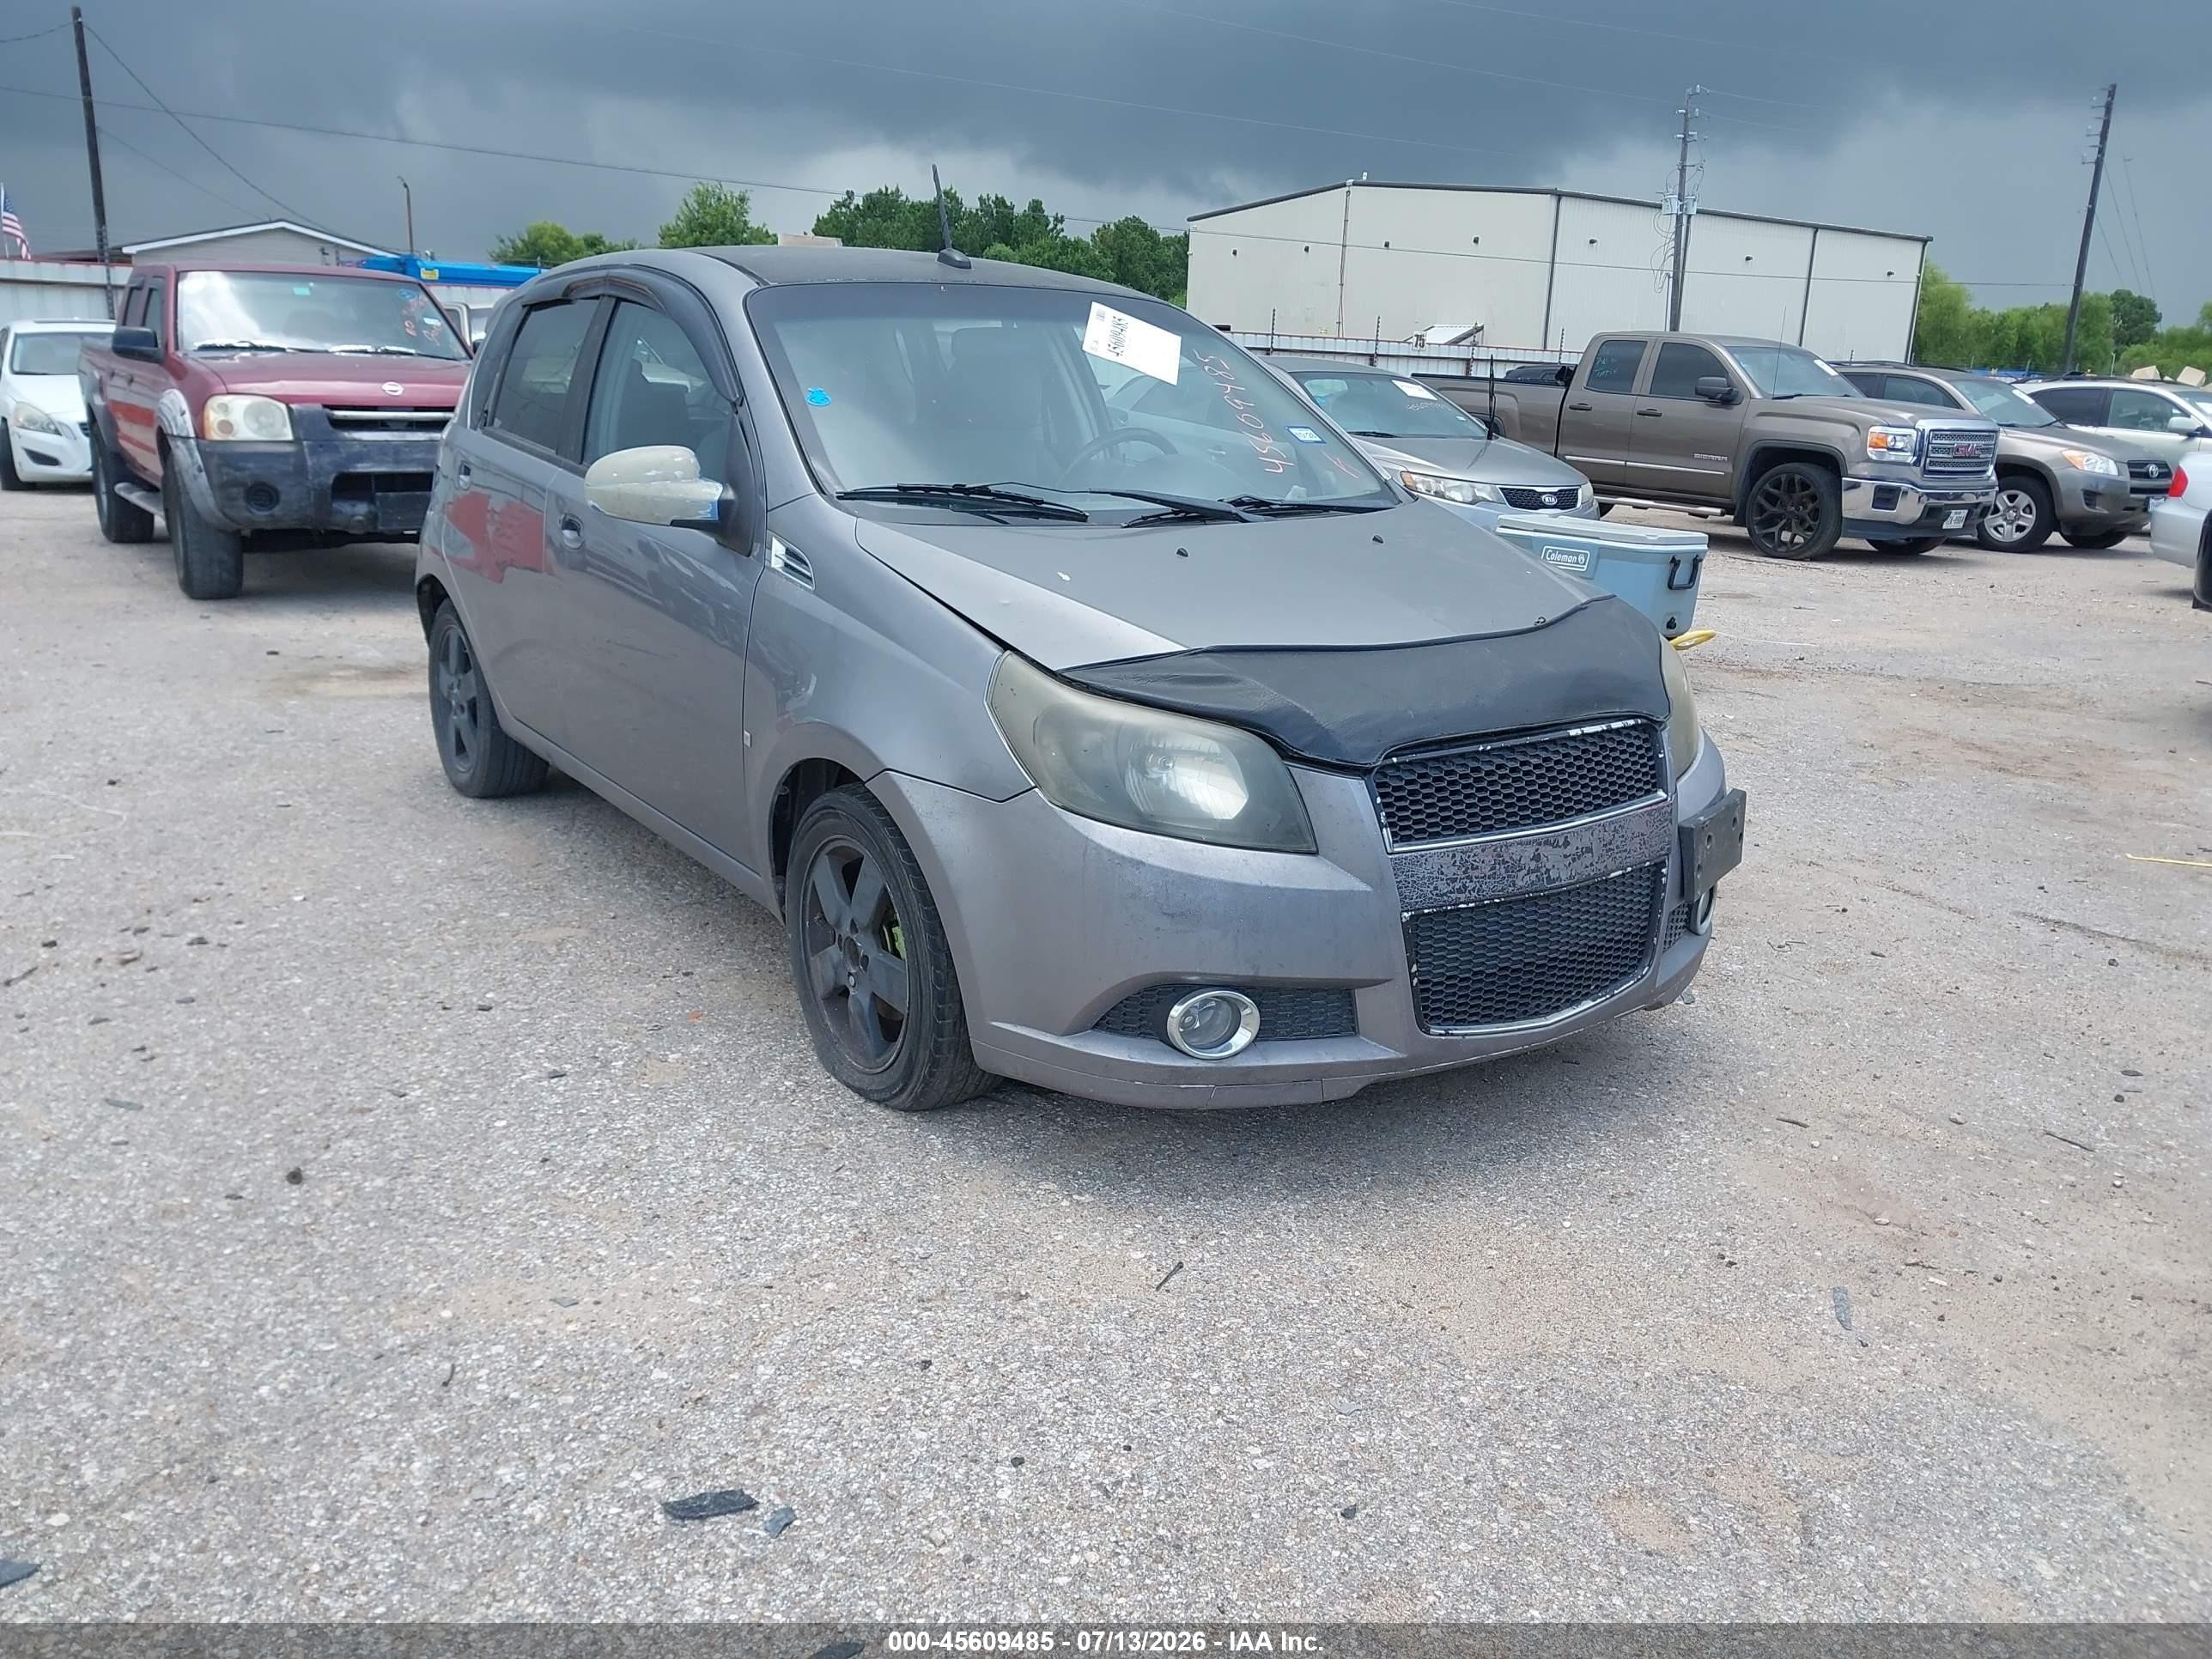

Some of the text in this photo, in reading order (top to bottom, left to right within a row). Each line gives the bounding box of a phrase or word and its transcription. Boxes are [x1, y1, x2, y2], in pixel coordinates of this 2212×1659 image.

[1107, 315, 1129, 357] 45609485
[1413, 333, 1425, 349] 75
[1192, 349, 1295, 473] 45609485
[1546, 550, 1577, 563] Coleman
